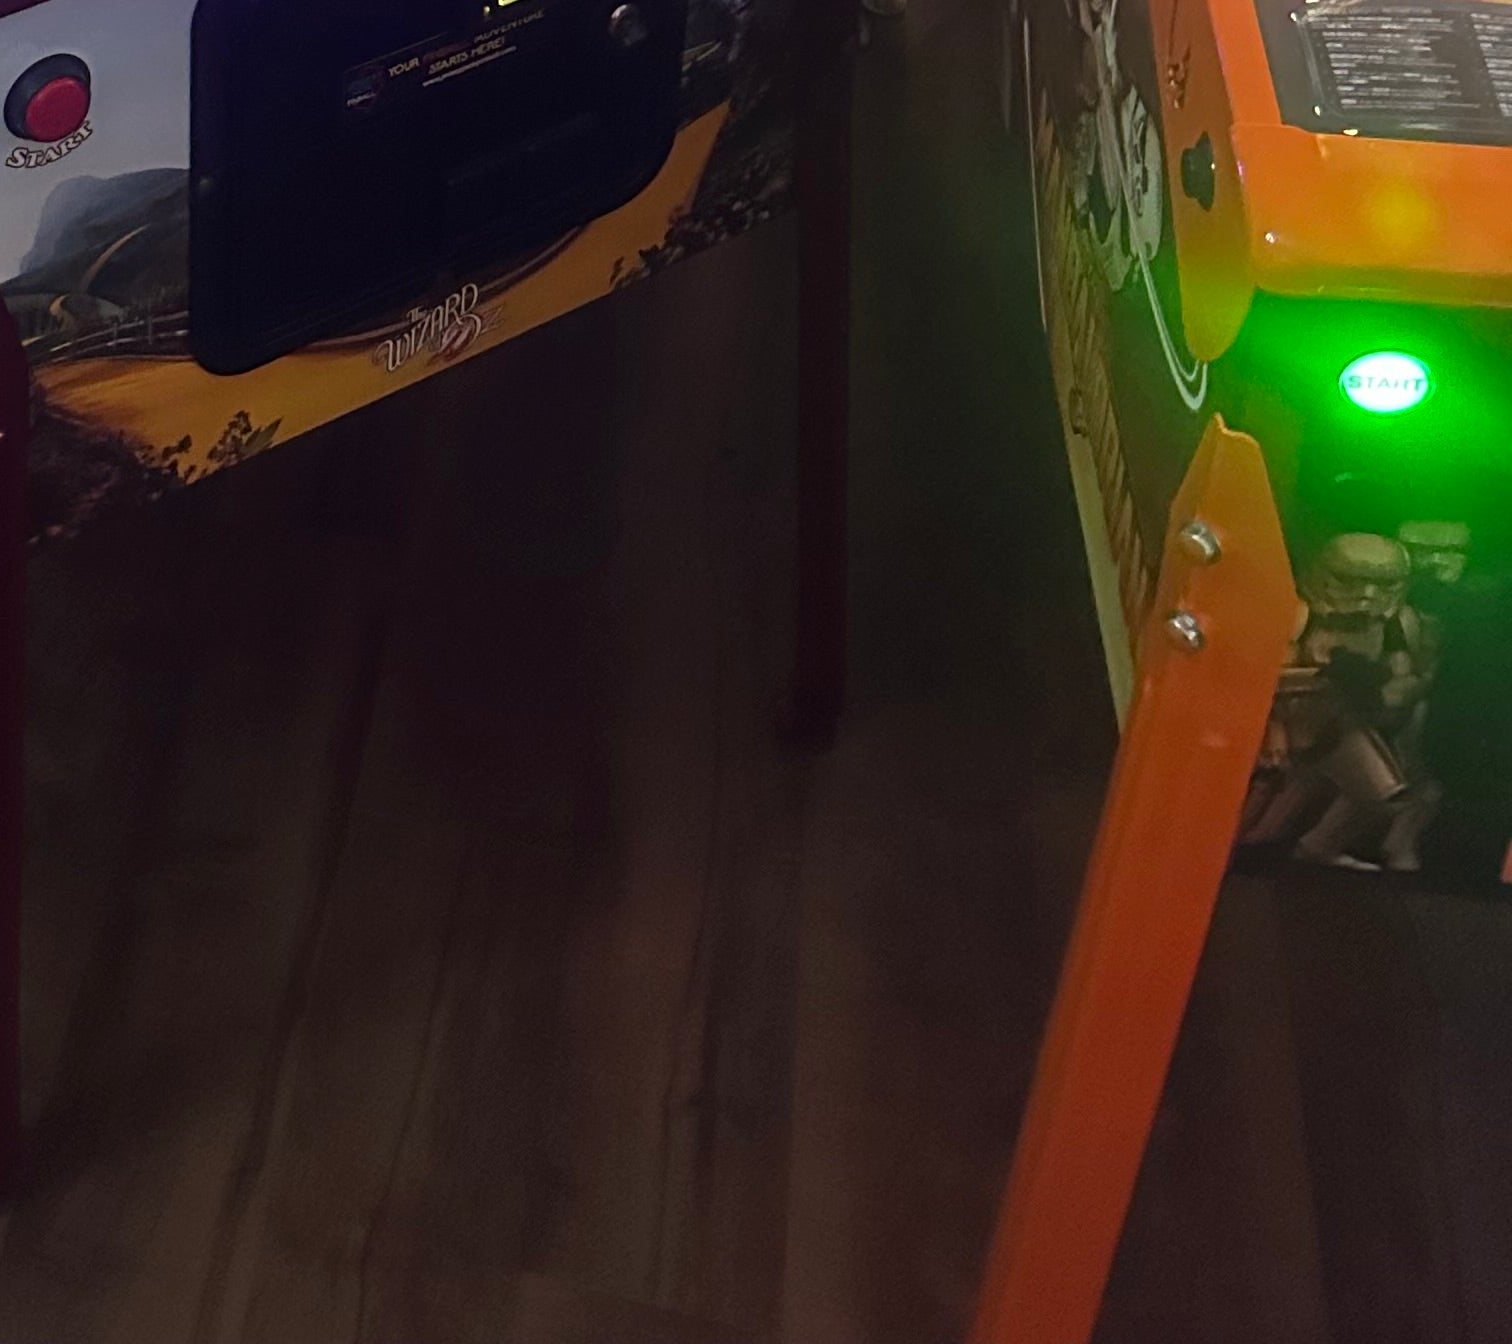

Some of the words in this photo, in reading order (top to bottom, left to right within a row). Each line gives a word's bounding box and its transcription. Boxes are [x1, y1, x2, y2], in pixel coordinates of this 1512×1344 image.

[388, 57, 420, 77] YOUR
[5, 120, 93, 168] START
[374, 283, 478, 372] WIZARD
